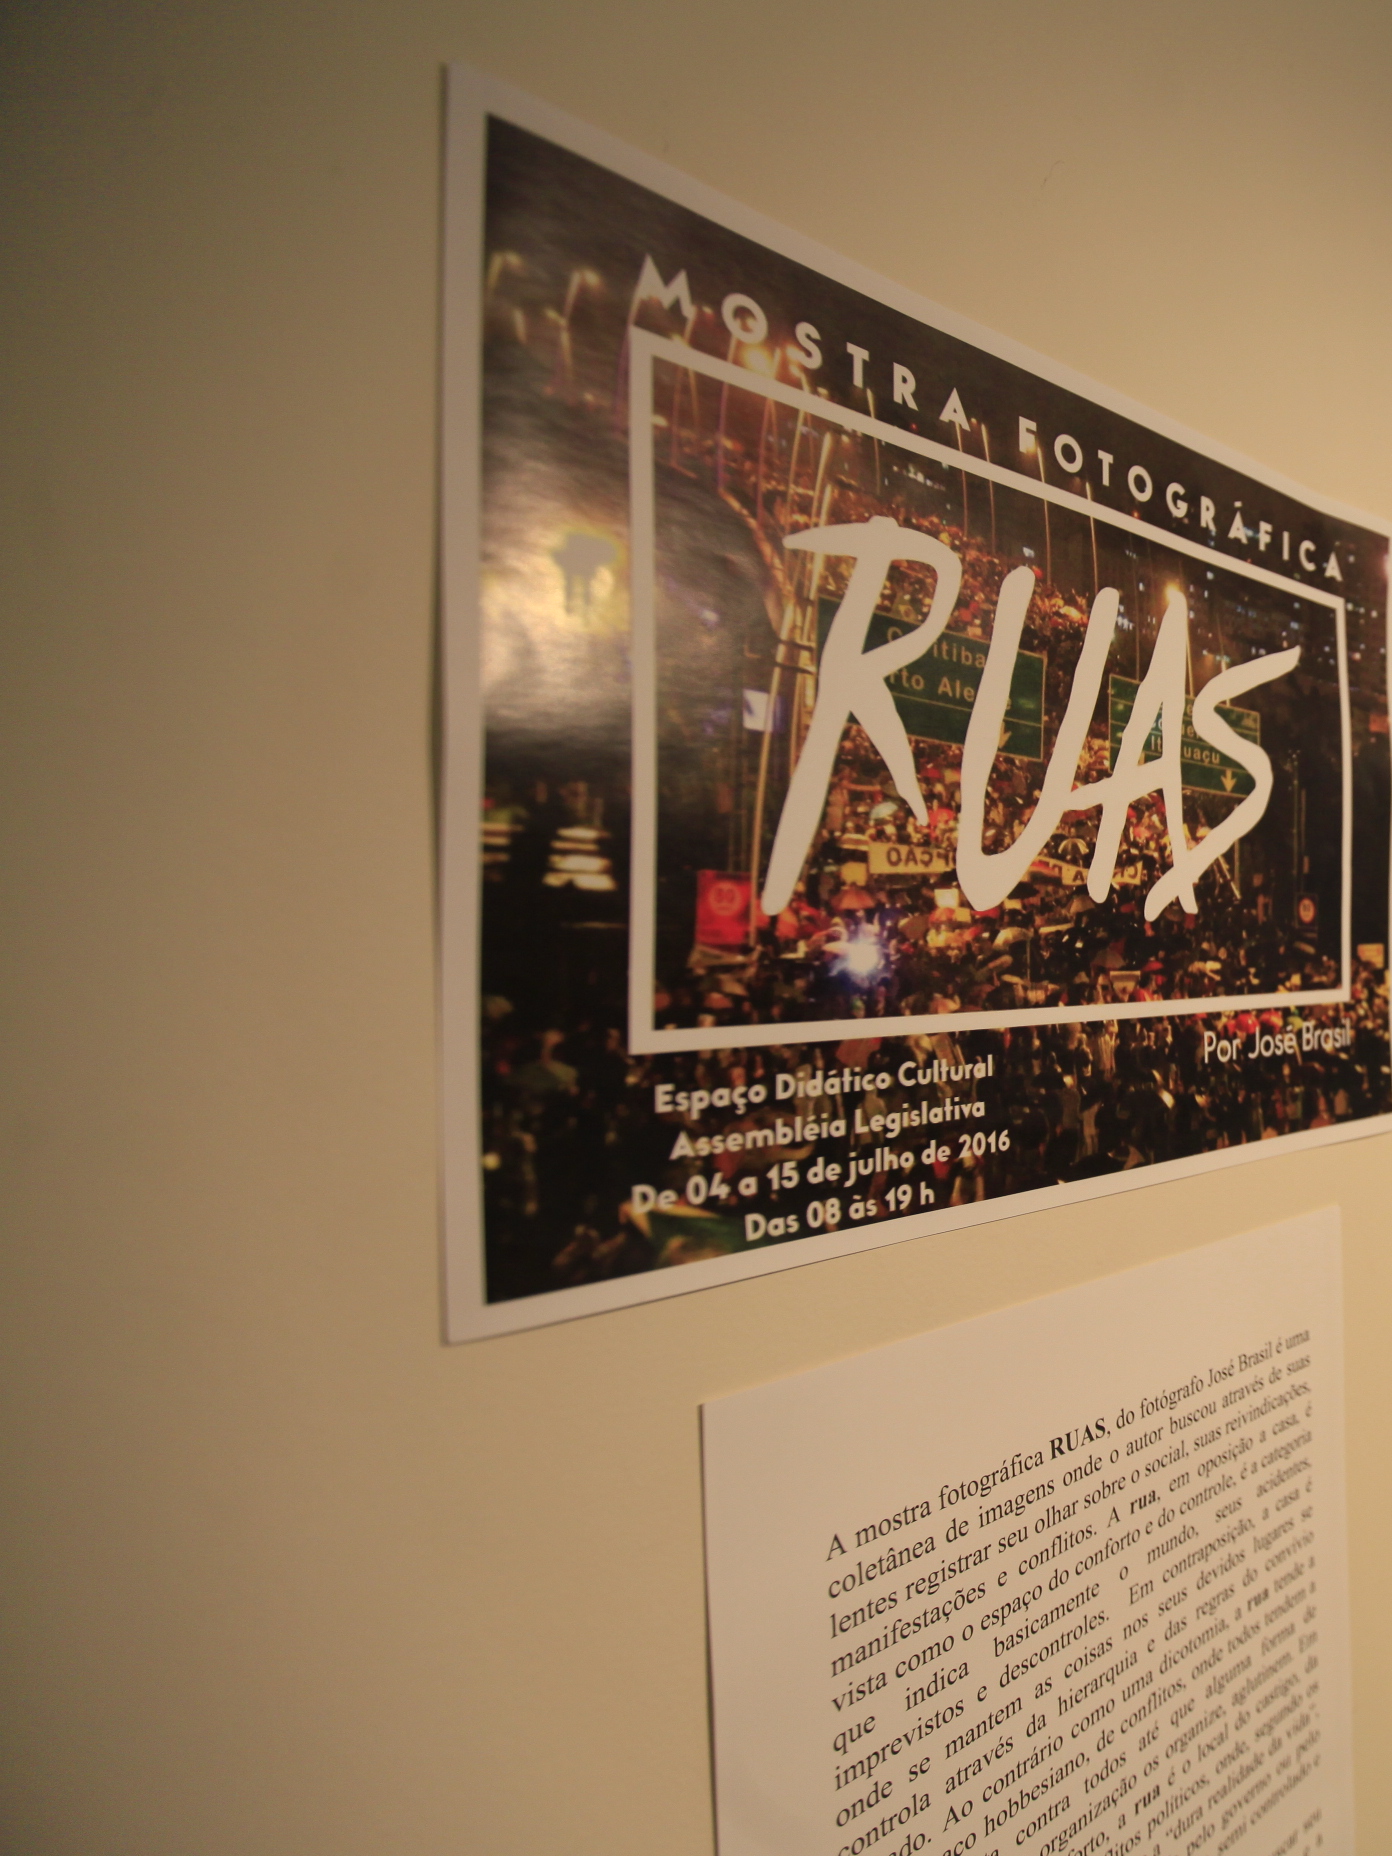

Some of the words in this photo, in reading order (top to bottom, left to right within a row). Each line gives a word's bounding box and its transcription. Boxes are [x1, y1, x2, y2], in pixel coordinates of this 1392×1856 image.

[634, 253, 972, 431] MOSTRA
[1018, 415, 1343, 582] FOTOGRÁFICA
[761, 516, 1301, 923] RUAS
[655, 1083, 768, 1120] Espaço
[776, 1066, 891, 1100] Didático
[898, 1054, 993, 1086] Cultural
[669, 1112, 847, 1160] Assembléia
[854, 1096, 985, 1138] Legislativa
[1203, 1031, 1241, 1064] Por
[1248, 1025, 1296, 1059] José
[1302, 1017, 1351, 1052] Brasil
[631, 1184, 678, 1214] De
[686, 1172, 732, 1205] 04
[738, 1176, 758, 1196] a
[766, 1161, 799, 1191] 15
[806, 1156, 842, 1184] de
[843, 1146, 915, 1188] julho
[921, 1139, 951, 1164] de
[957, 1129, 1010, 1158] 2016
[744, 1215, 799, 1242] Das
[806, 1197, 842, 1229] 08
[848, 1195, 878, 1220] às
[884, 1184, 912, 1212] 19
[919, 1180, 935, 1205] h
[826, 1534, 848, 1561] A
[855, 1501, 932, 1548] mostra
[938, 1451, 1044, 1510] fotográfica
[1049, 1417, 1111, 1460] RUAS,
[1116, 1408, 1135, 1429] do
[1140, 1375, 1204, 1419] fotógrafo
[1207, 1359, 1234, 1387] José
[828, 1536, 936, 1599] coletânea
[945, 1518, 969, 1543] de
[978, 1479, 1055, 1529] imagens
[1063, 1454, 1102, 1487] onde
[1110, 1449, 1119, 1464] o
[1126, 1426, 1164, 1456] autor
[1169, 1401, 1217, 1434] buscou
[830, 1591, 898, 1639] lentes
[905, 1544, 992, 1601] registrar
[998, 1526, 1028, 1554] seu
[1034, 1500, 1079, 1534] olhar
[1084, 1476, 1126, 1509] sobre
[1131, 1469, 1140, 1484] o
[1145, 1440, 1189, 1477] social,
[1194, 1427, 1222, 1451] suas
[831, 1582, 986, 1677] manifestações
[997, 1571, 1007, 1587] e
[1018, 1524, 1097, 1576] conflitos.
[1107, 1506, 1120, 1528] A
[1130, 1490, 1161, 1515] rua,
[1169, 1472, 1190, 1492] em
[831, 1672, 888, 1712] vista
[895, 1635, 954, 1678] como
[962, 1624, 974, 1641] o
[980, 1585, 1043, 1631] espaço
[1048, 1568, 1069, 1591] do
[1075, 1529, 1141, 1576] conforto
[1145, 1521, 1153, 1535] e
[1157, 1507, 1175, 1528] do
[1179, 1474, 1236, 1515] controle,
[833, 1716, 875, 1755] que
[905, 1662, 969, 1711] indica
[993, 1583, 1100, 1658] basicamente
[1119, 1566, 1129, 1581] o
[1147, 1525, 1199, 1564] mundo,
[835, 1699, 964, 1791] imprevistos
[977, 1685, 987, 1702] e
[999, 1610, 1109, 1688] descontroles.
[1129, 1580, 1154, 1605] Em
[1162, 1518, 1256, 1583] contraposição,
[836, 1781, 892, 1827] onde
[909, 1757, 930, 1783] se
[945, 1697, 1023, 1760] mantem
[1035, 1676, 1052, 1699] as
[1064, 1637, 1113, 1679] coisas
[1123, 1613, 1149, 1640] nos
[1158, 1587, 1188, 1617] seus
[838, 1793, 931, 1855] controla
[945, 1736, 1014, 1794] através
[1026, 1713, 1047, 1738] da
[1058, 1650, 1138, 1716] hierarquia
[1147, 1639, 1155, 1653] e
[1164, 1617, 1187, 1641] das
[943, 1800, 973, 1833] Ao
[982, 1735, 1063, 1803] contrário
[1071, 1698, 1115, 1739] como
[1122, 1670, 1153, 1702] uma
[1159, 1618, 1230, 1675] dicotomia,
[984, 1752, 1090, 1838] hobbesiano,
[1096, 1729, 1115, 1752] de
[1120, 1678, 1187, 1734] conflitos,
[1016, 1795, 1070, 1846] contra
[1084, 1752, 1126, 1794] todos
[1139, 1721, 1159, 1752] até
[1170, 1698, 1195, 1728] que
[1040, 1774, 1137, 1855] organização
[1143, 1756, 1159, 1777] os
[1118, 1814, 1126, 1830] a
[1134, 1784, 1160, 1816] rua
[1168, 1771, 1175, 1786] é
